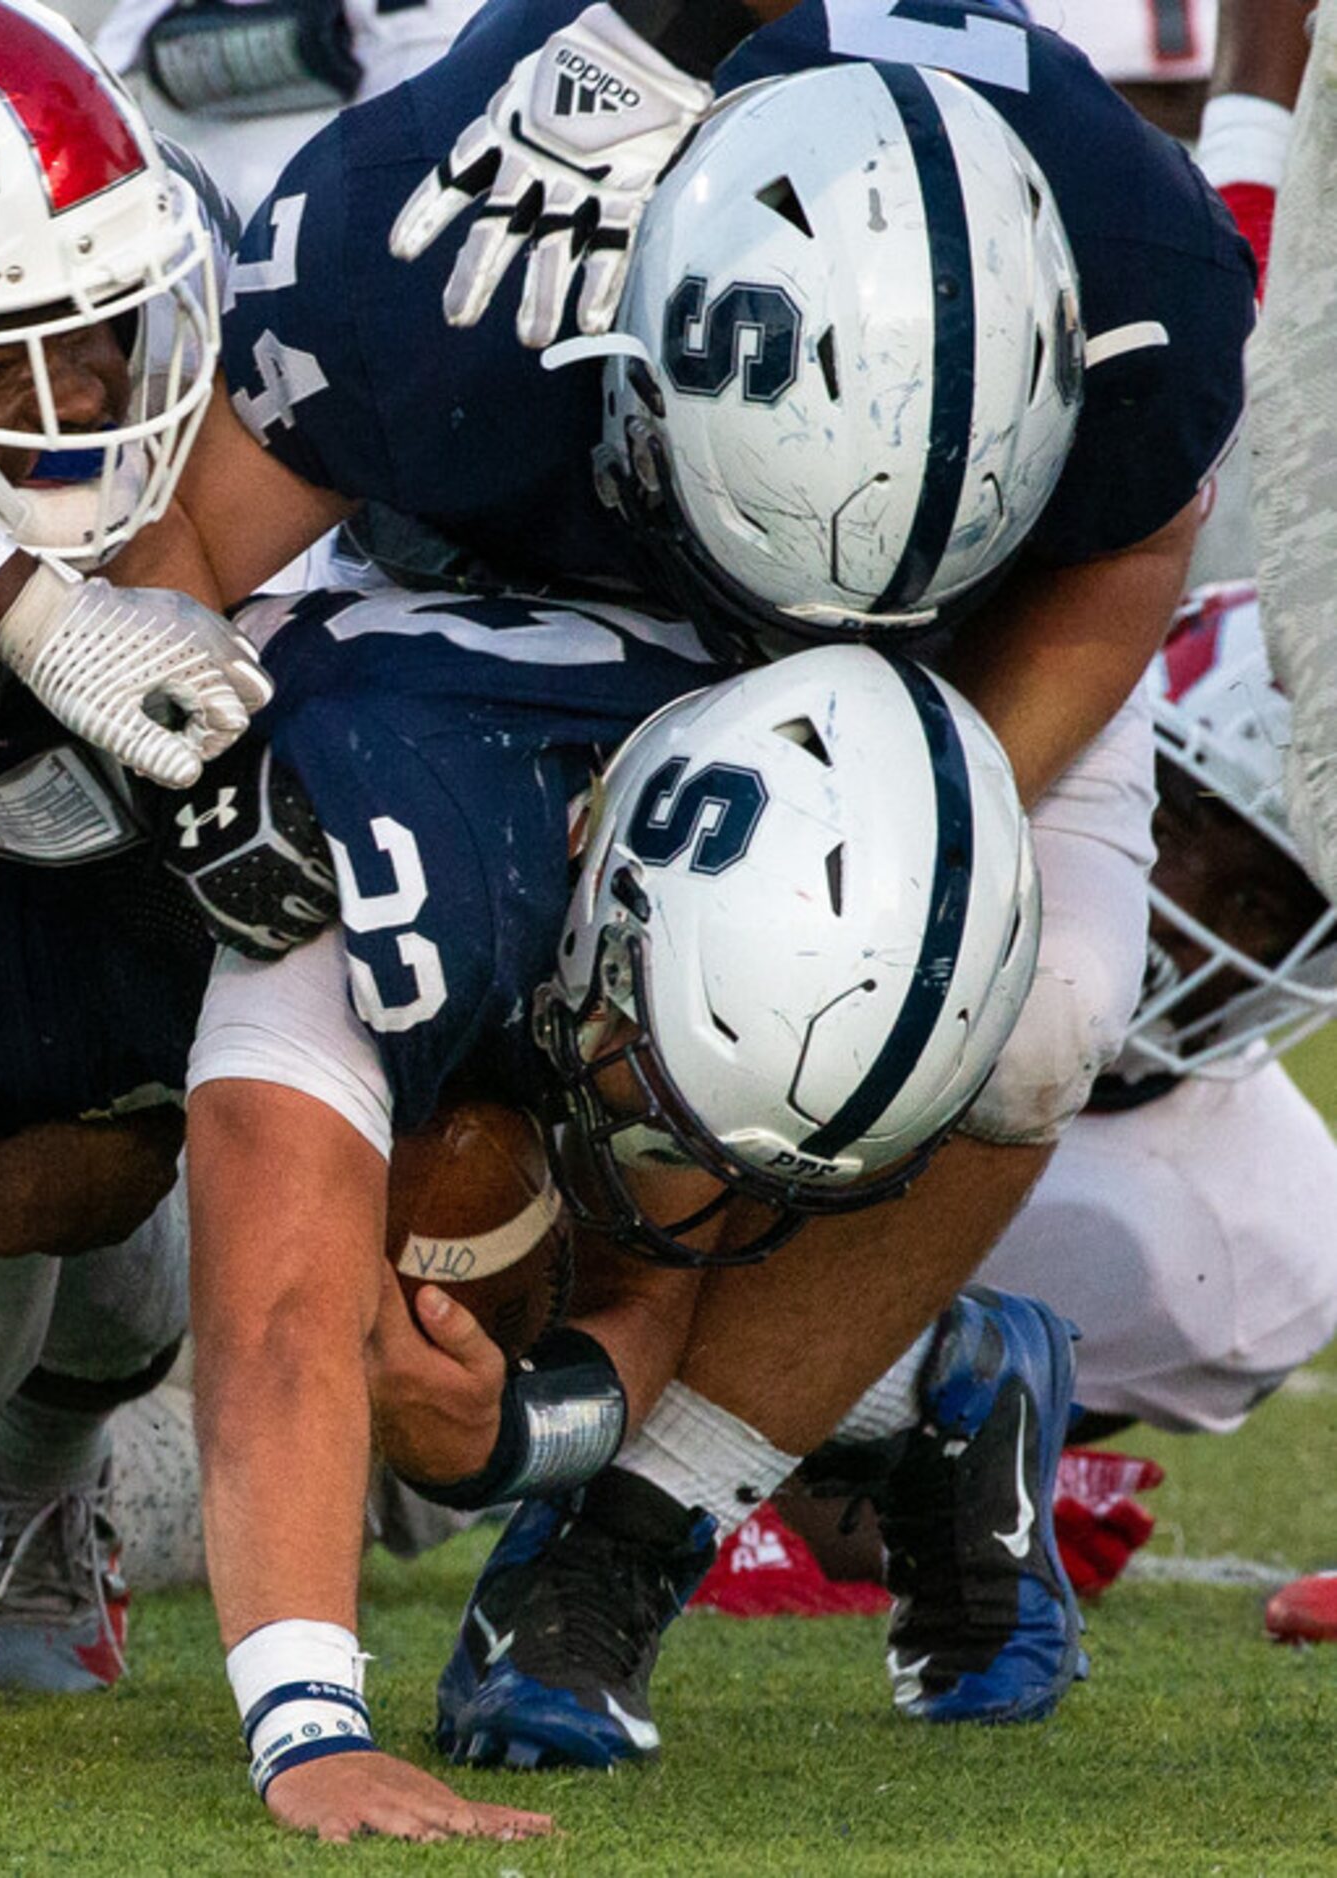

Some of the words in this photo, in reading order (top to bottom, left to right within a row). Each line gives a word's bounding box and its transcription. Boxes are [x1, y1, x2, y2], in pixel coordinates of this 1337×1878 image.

[554, 48, 641, 108] adidas
[661, 273, 803, 405] S
[627, 756, 770, 876] S
